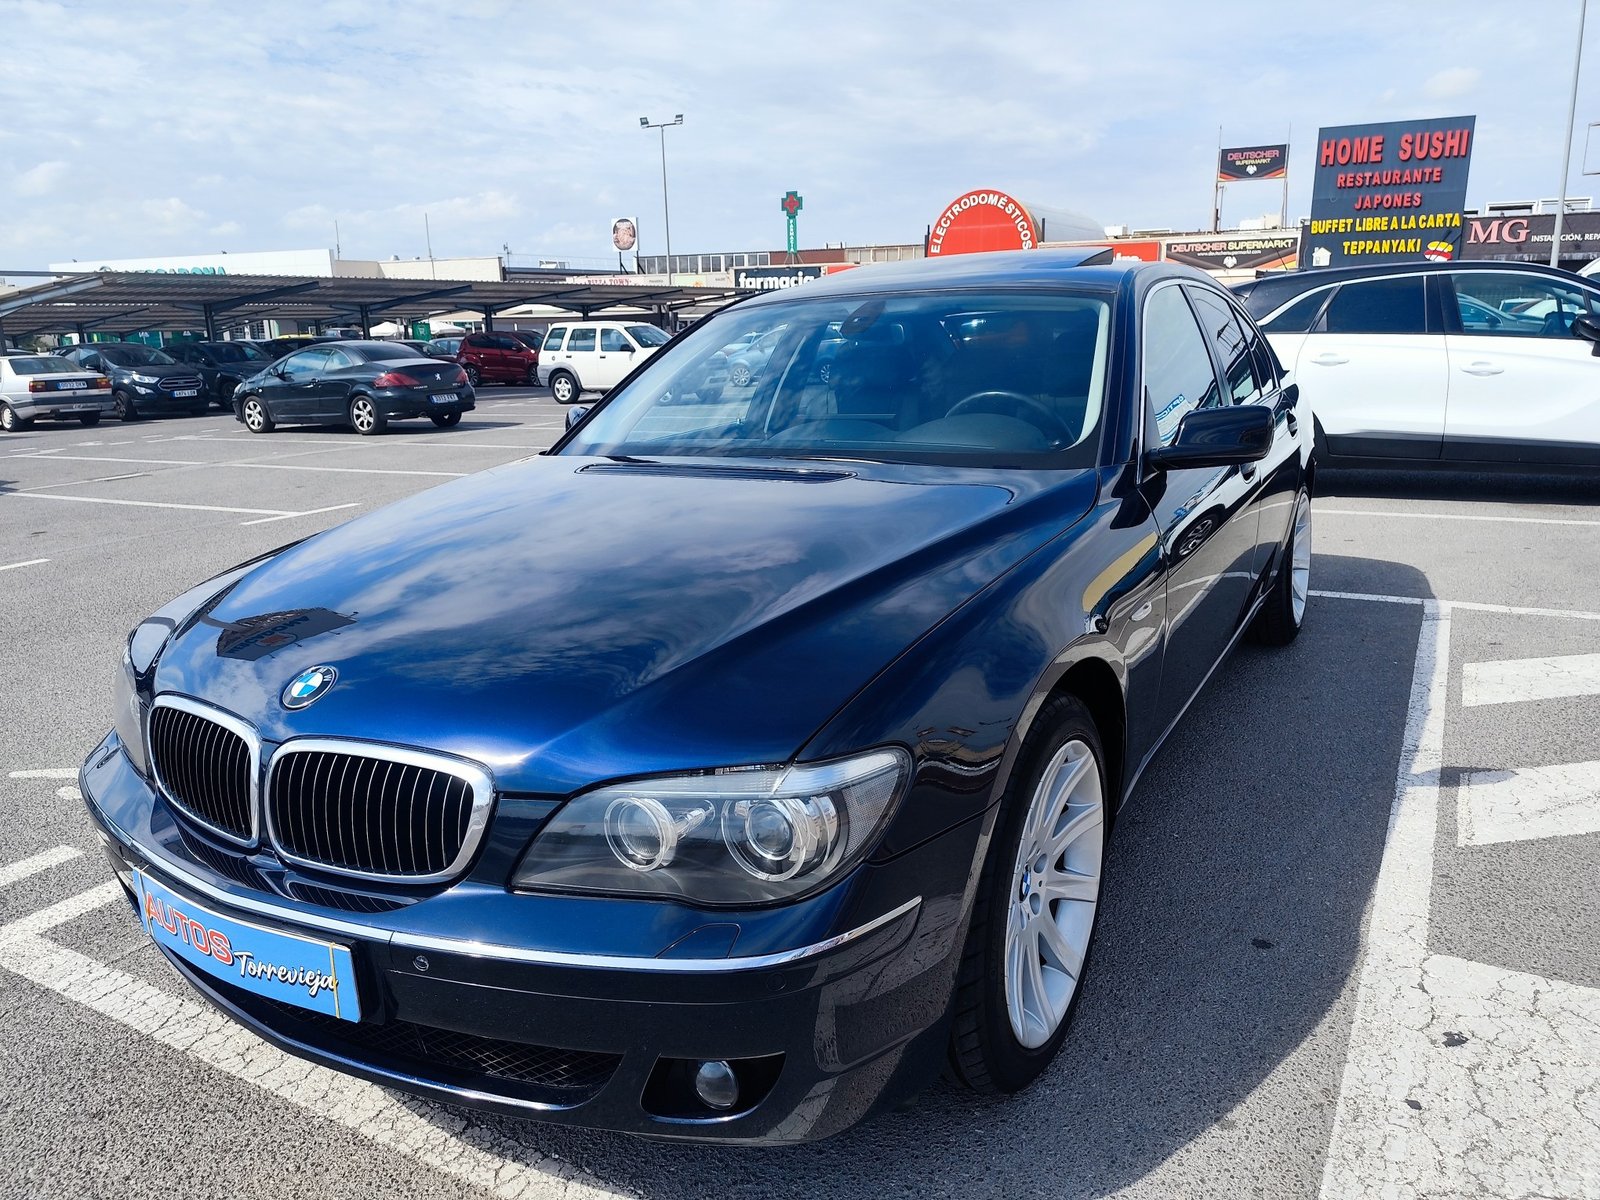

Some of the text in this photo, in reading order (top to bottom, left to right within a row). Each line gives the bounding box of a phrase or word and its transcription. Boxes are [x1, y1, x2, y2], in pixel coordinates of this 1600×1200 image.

[1227, 150, 1280, 160] DEUTSCHER
[1320, 128, 1470, 167] HOME SUSHI
[1235, 158, 1271, 166] SUPERMARKT
[1336, 167, 1442, 189] RESTAURANTE
[1354, 192, 1422, 210] JAPONES
[930, 193, 1033, 254] ELECTRODOMÉSTICOS
[1311, 213, 1461, 234] BUFFET LIBRE A LA CARTA
[1466, 219, 1530, 244] MG
[1171, 239, 1294, 252] DEUTSCHER SUPERMARKT
[1343, 238, 1422, 255] TEPPANYAKI
[144, 891, 339, 999] AUTOS Torrevieja
